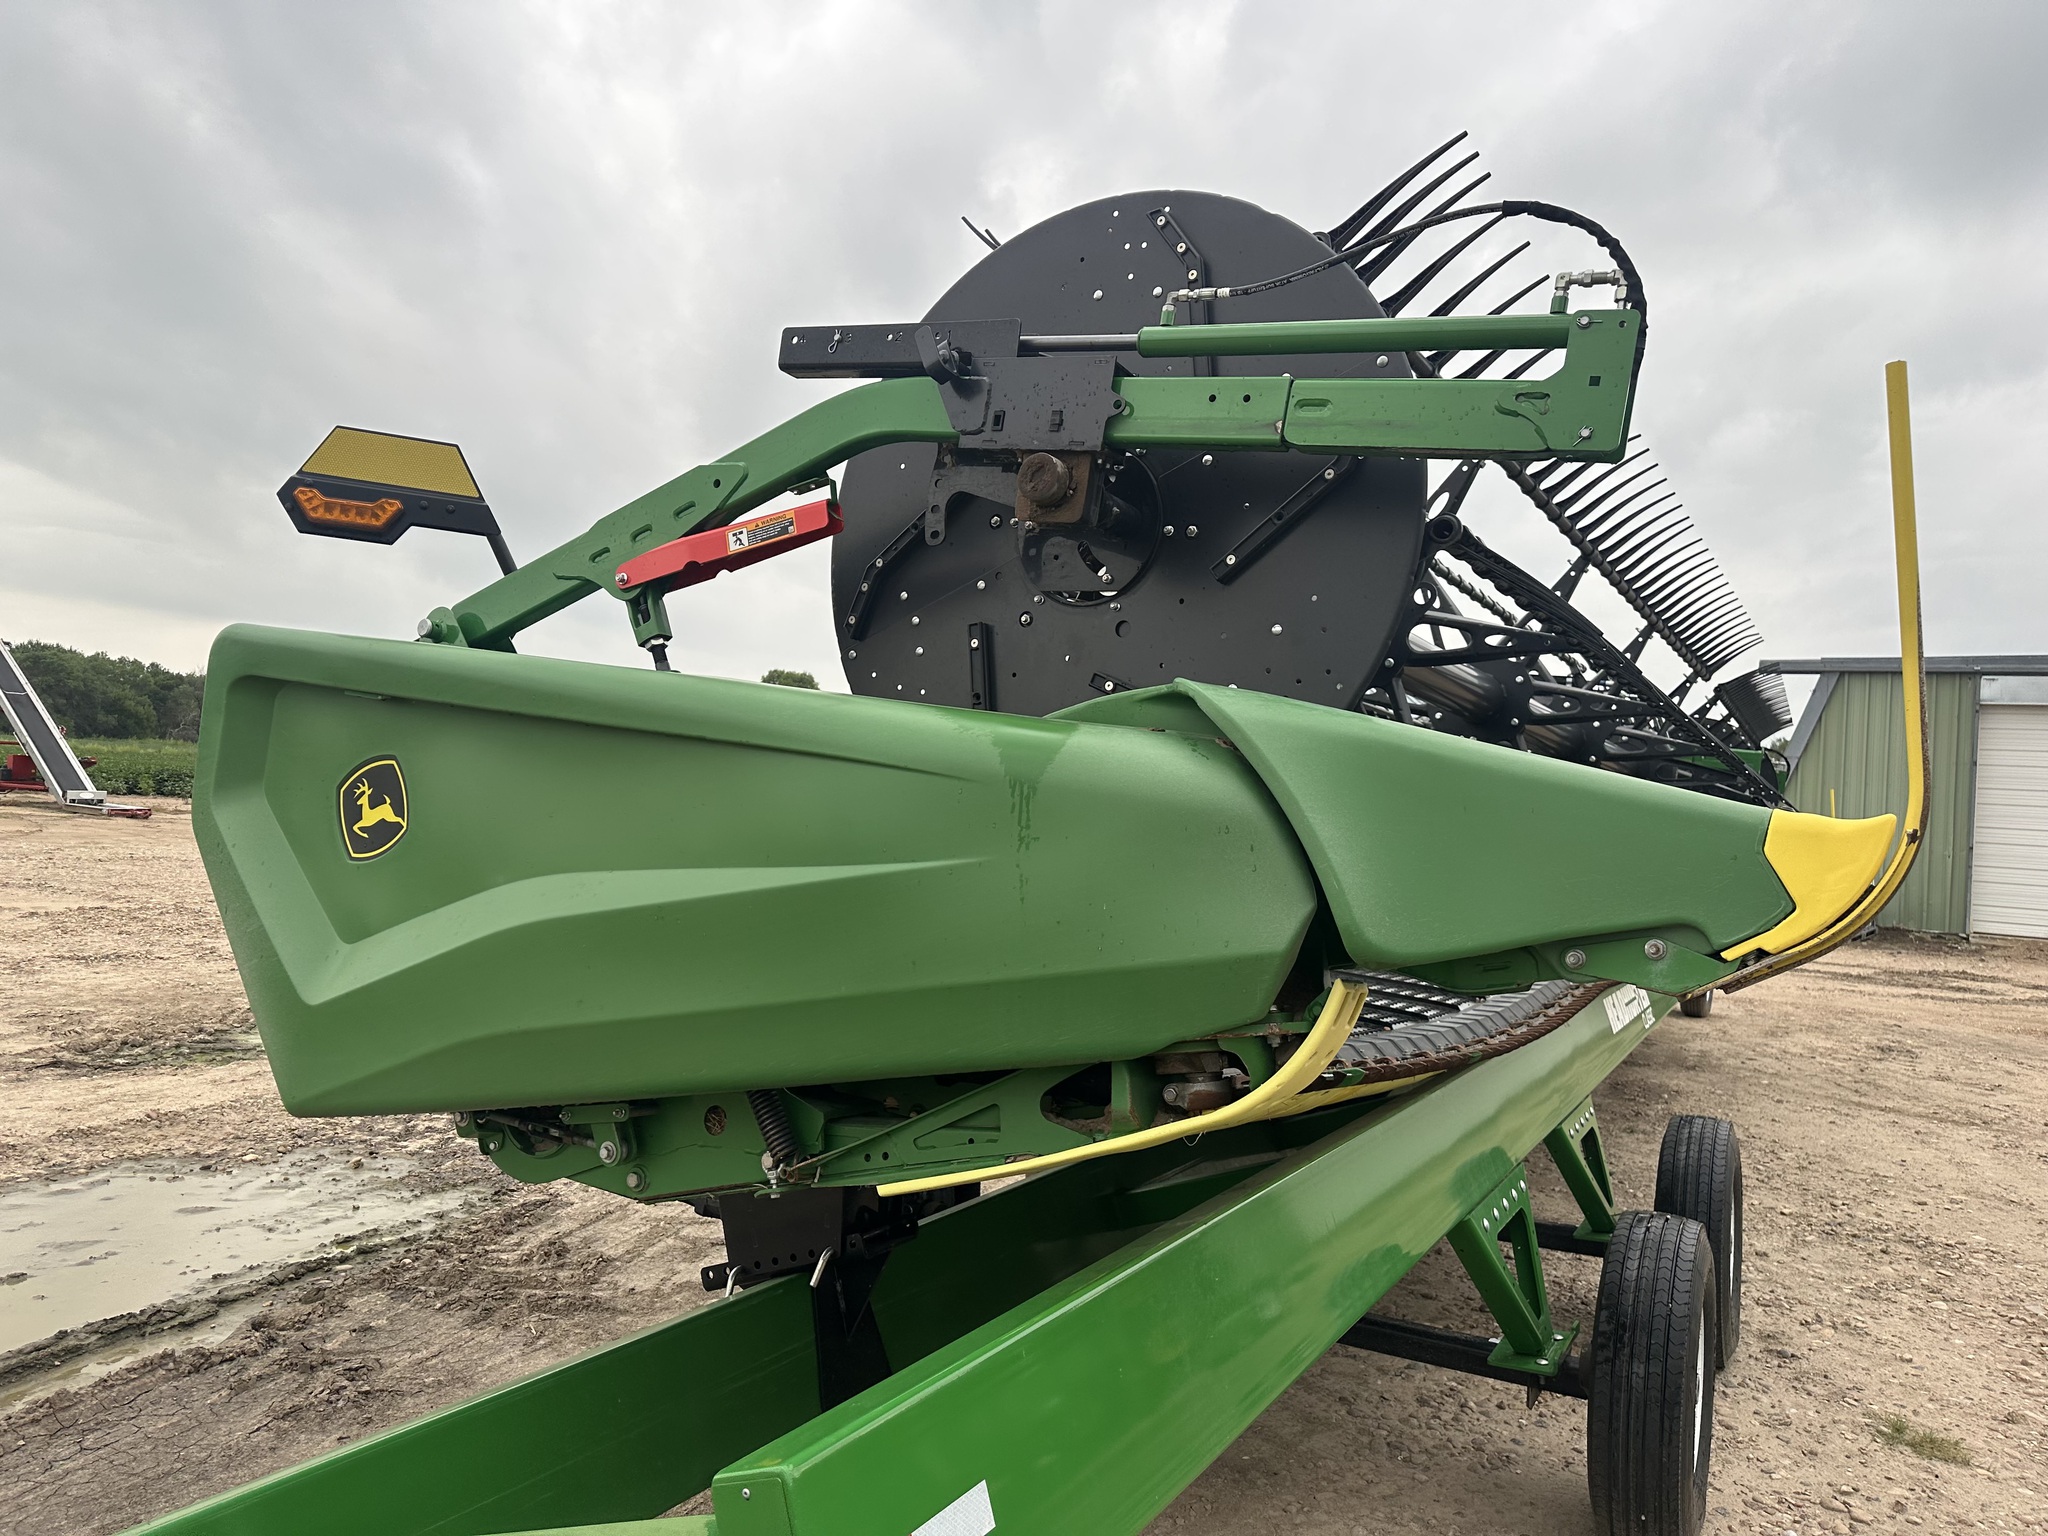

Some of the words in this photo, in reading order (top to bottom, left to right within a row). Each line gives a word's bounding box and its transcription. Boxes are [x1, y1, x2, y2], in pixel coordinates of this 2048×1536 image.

[798, 334, 807, 344] 4
[844, 333, 853, 343] 3
[894, 331, 903, 342] 2
[760, 513, 787, 526] WARNING
